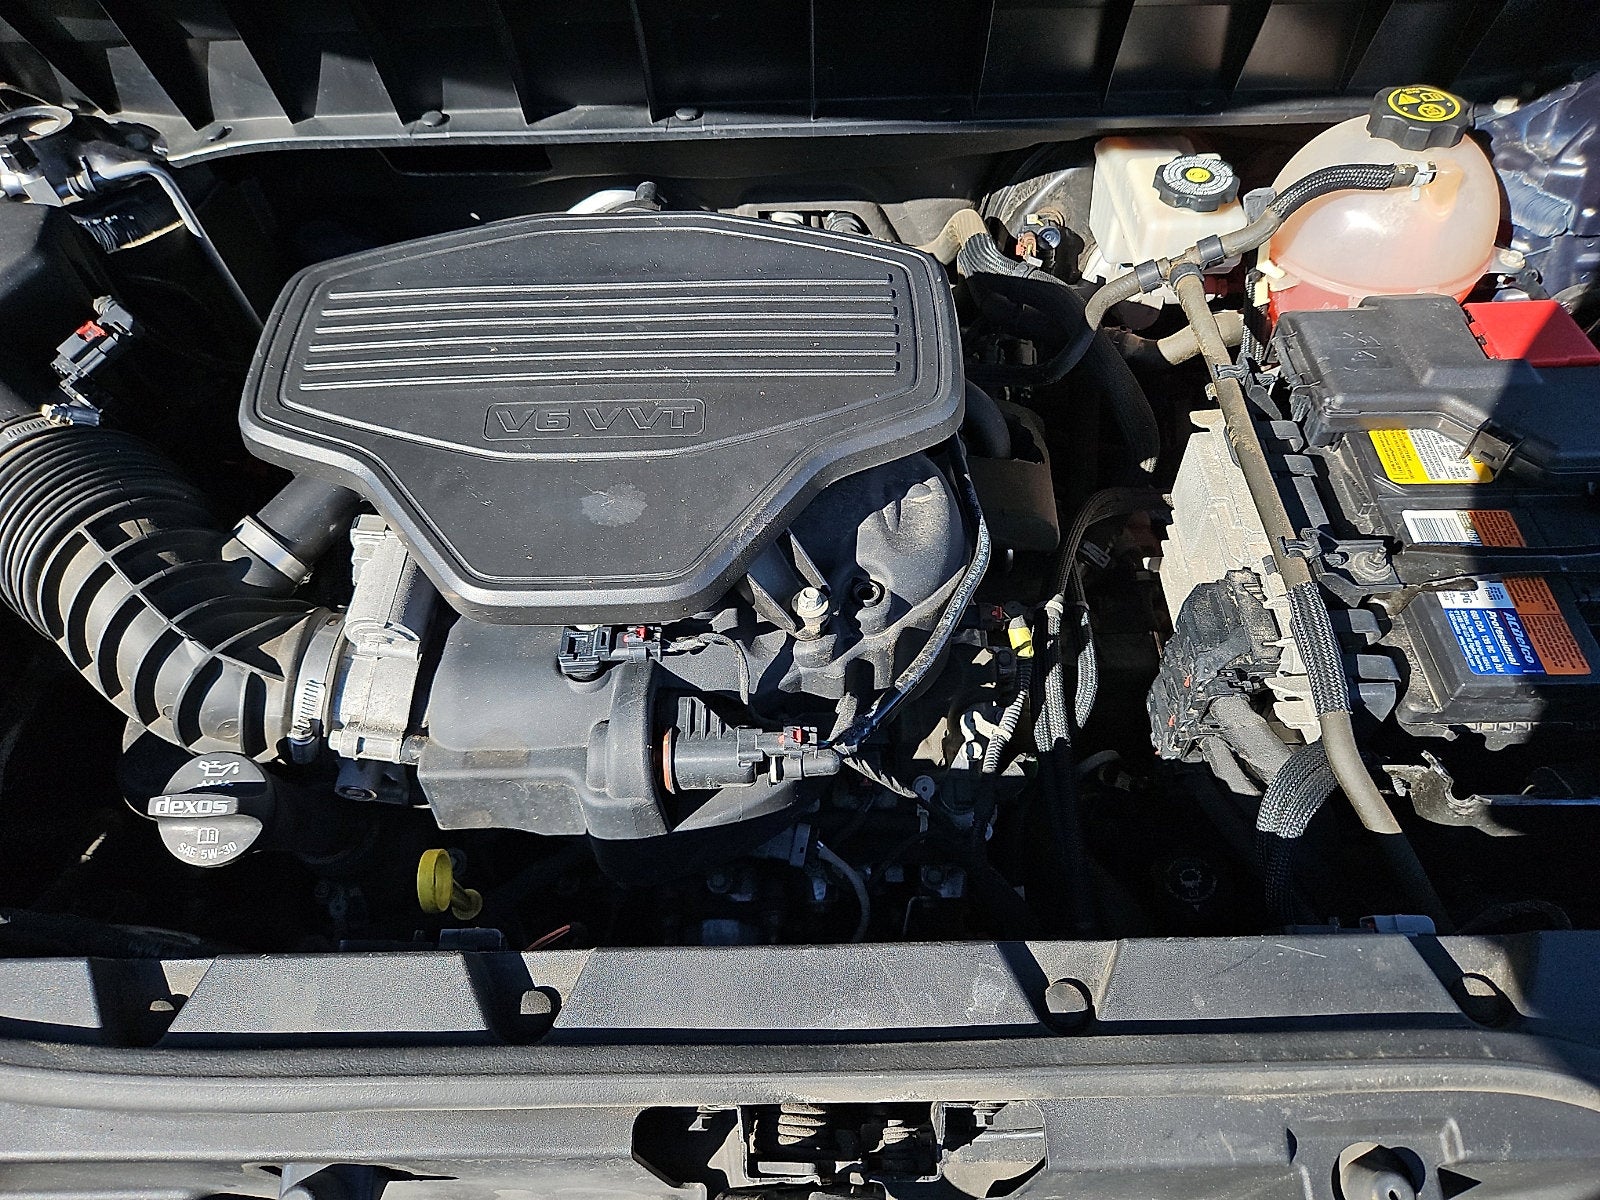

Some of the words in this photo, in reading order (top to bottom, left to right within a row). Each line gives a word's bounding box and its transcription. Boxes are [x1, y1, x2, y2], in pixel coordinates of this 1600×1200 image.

[495, 408, 571, 432] V6
[583, 406, 696, 430] VVT
[1485, 609, 1521, 666] Professional
[1503, 611, 1535, 664] ACDelco
[155, 796, 232, 814] dexos
[177, 842, 198, 858] SAE
[200, 841, 238, 860] 5W-30
